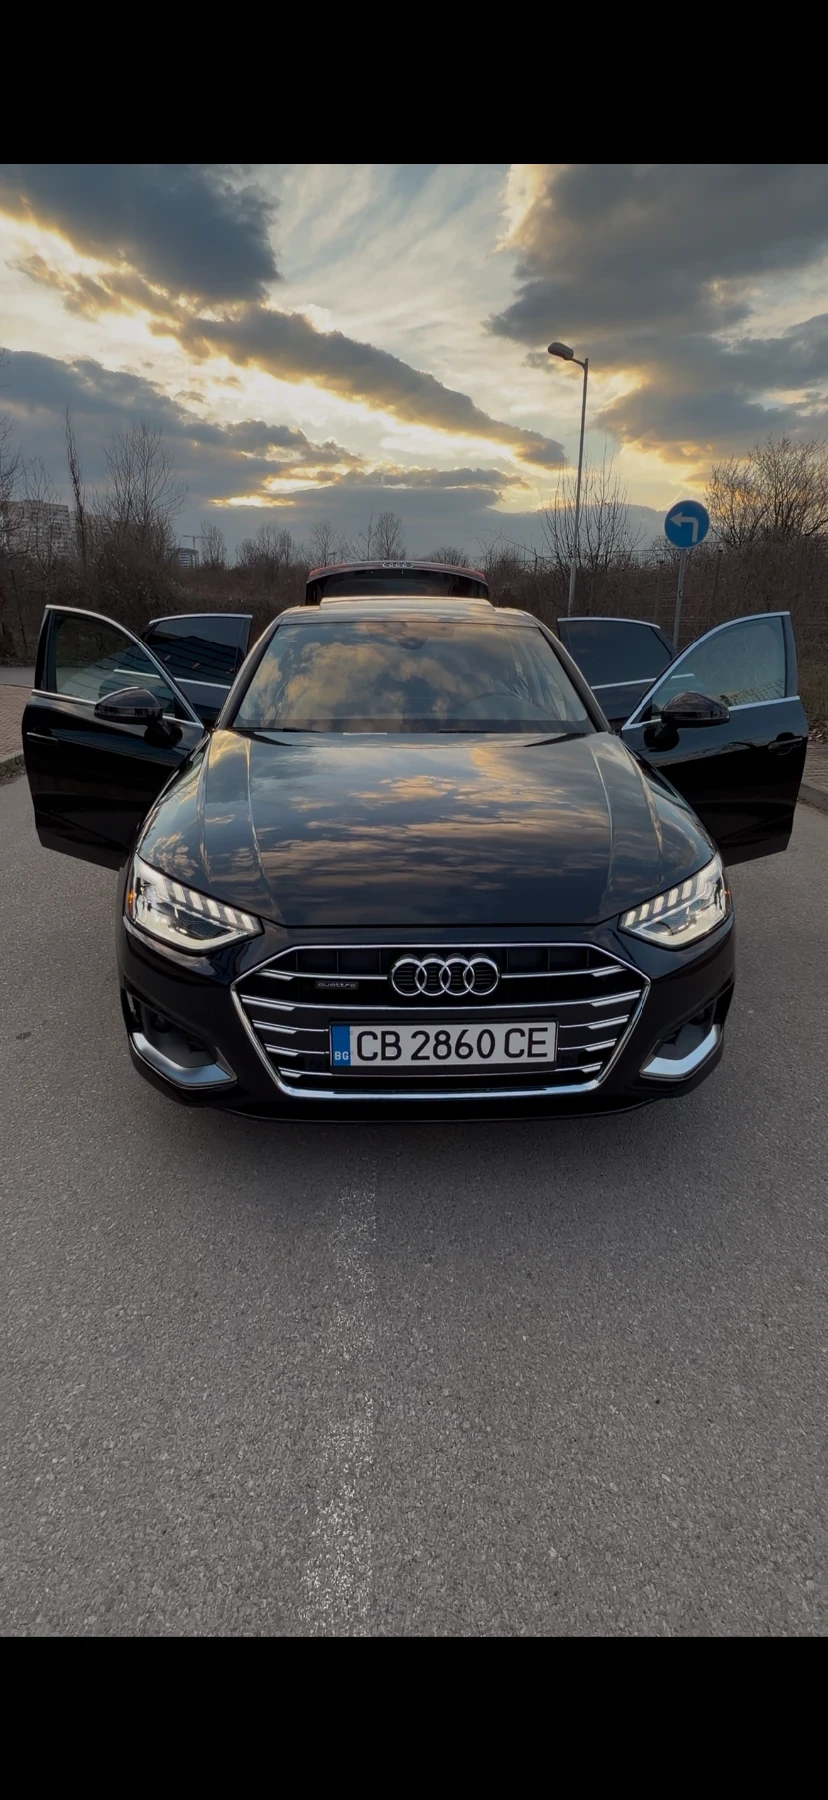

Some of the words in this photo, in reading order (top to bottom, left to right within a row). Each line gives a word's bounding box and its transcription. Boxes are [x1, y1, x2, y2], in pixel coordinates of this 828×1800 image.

[356, 1030, 402, 1062] CB
[410, 1029, 496, 1061] 2860
[504, 1027, 549, 1058] CE
[334, 1051, 349, 1061] BG
